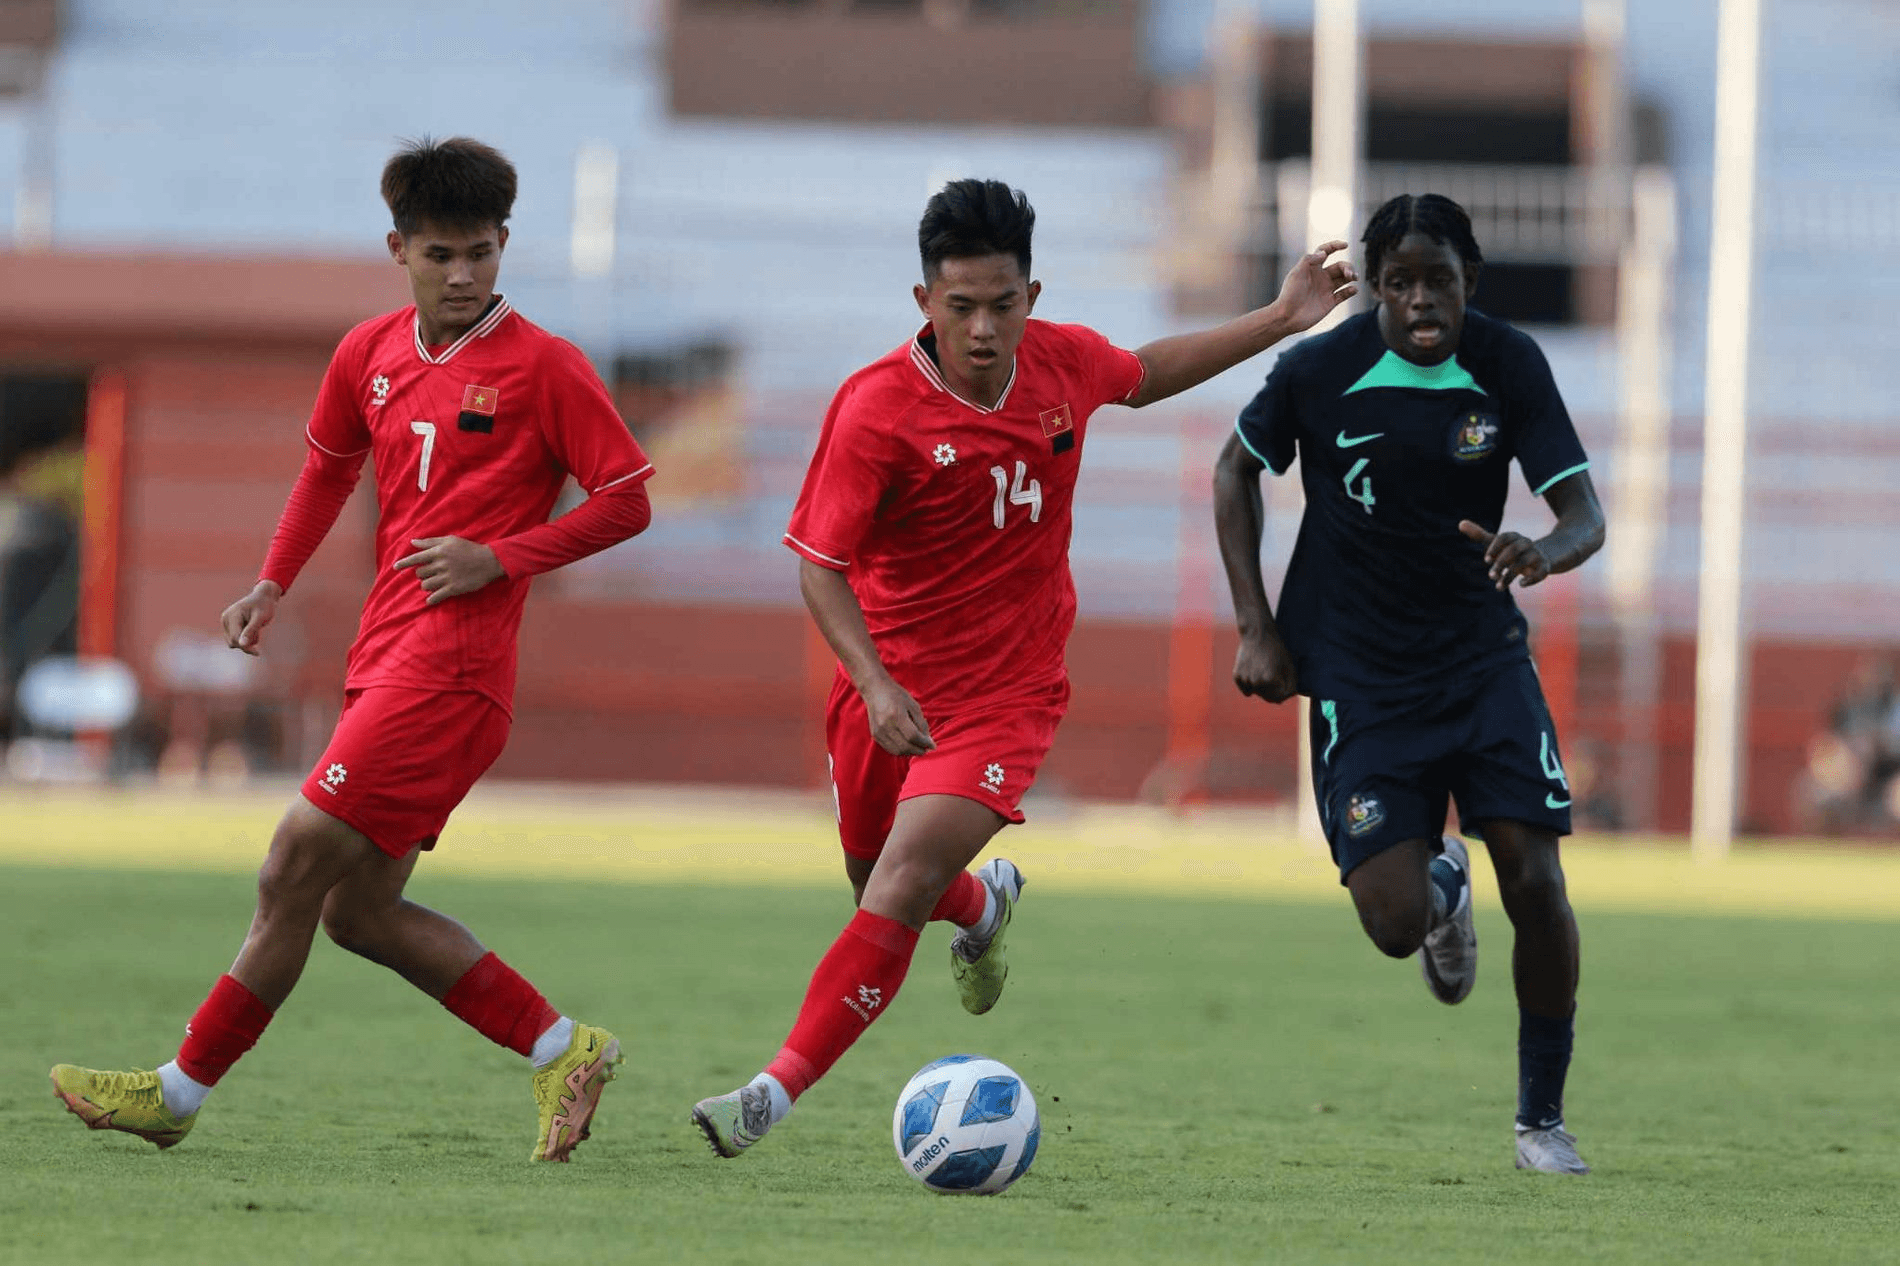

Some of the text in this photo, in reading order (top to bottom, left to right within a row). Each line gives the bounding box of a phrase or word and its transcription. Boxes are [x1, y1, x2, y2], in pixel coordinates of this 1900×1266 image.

[411, 421, 436, 492] 7
[990, 460, 1042, 529] 14
[1343, 458, 1375, 515] 4
[1540, 731, 1568, 790] 4
[912, 1136, 950, 1173] molten
